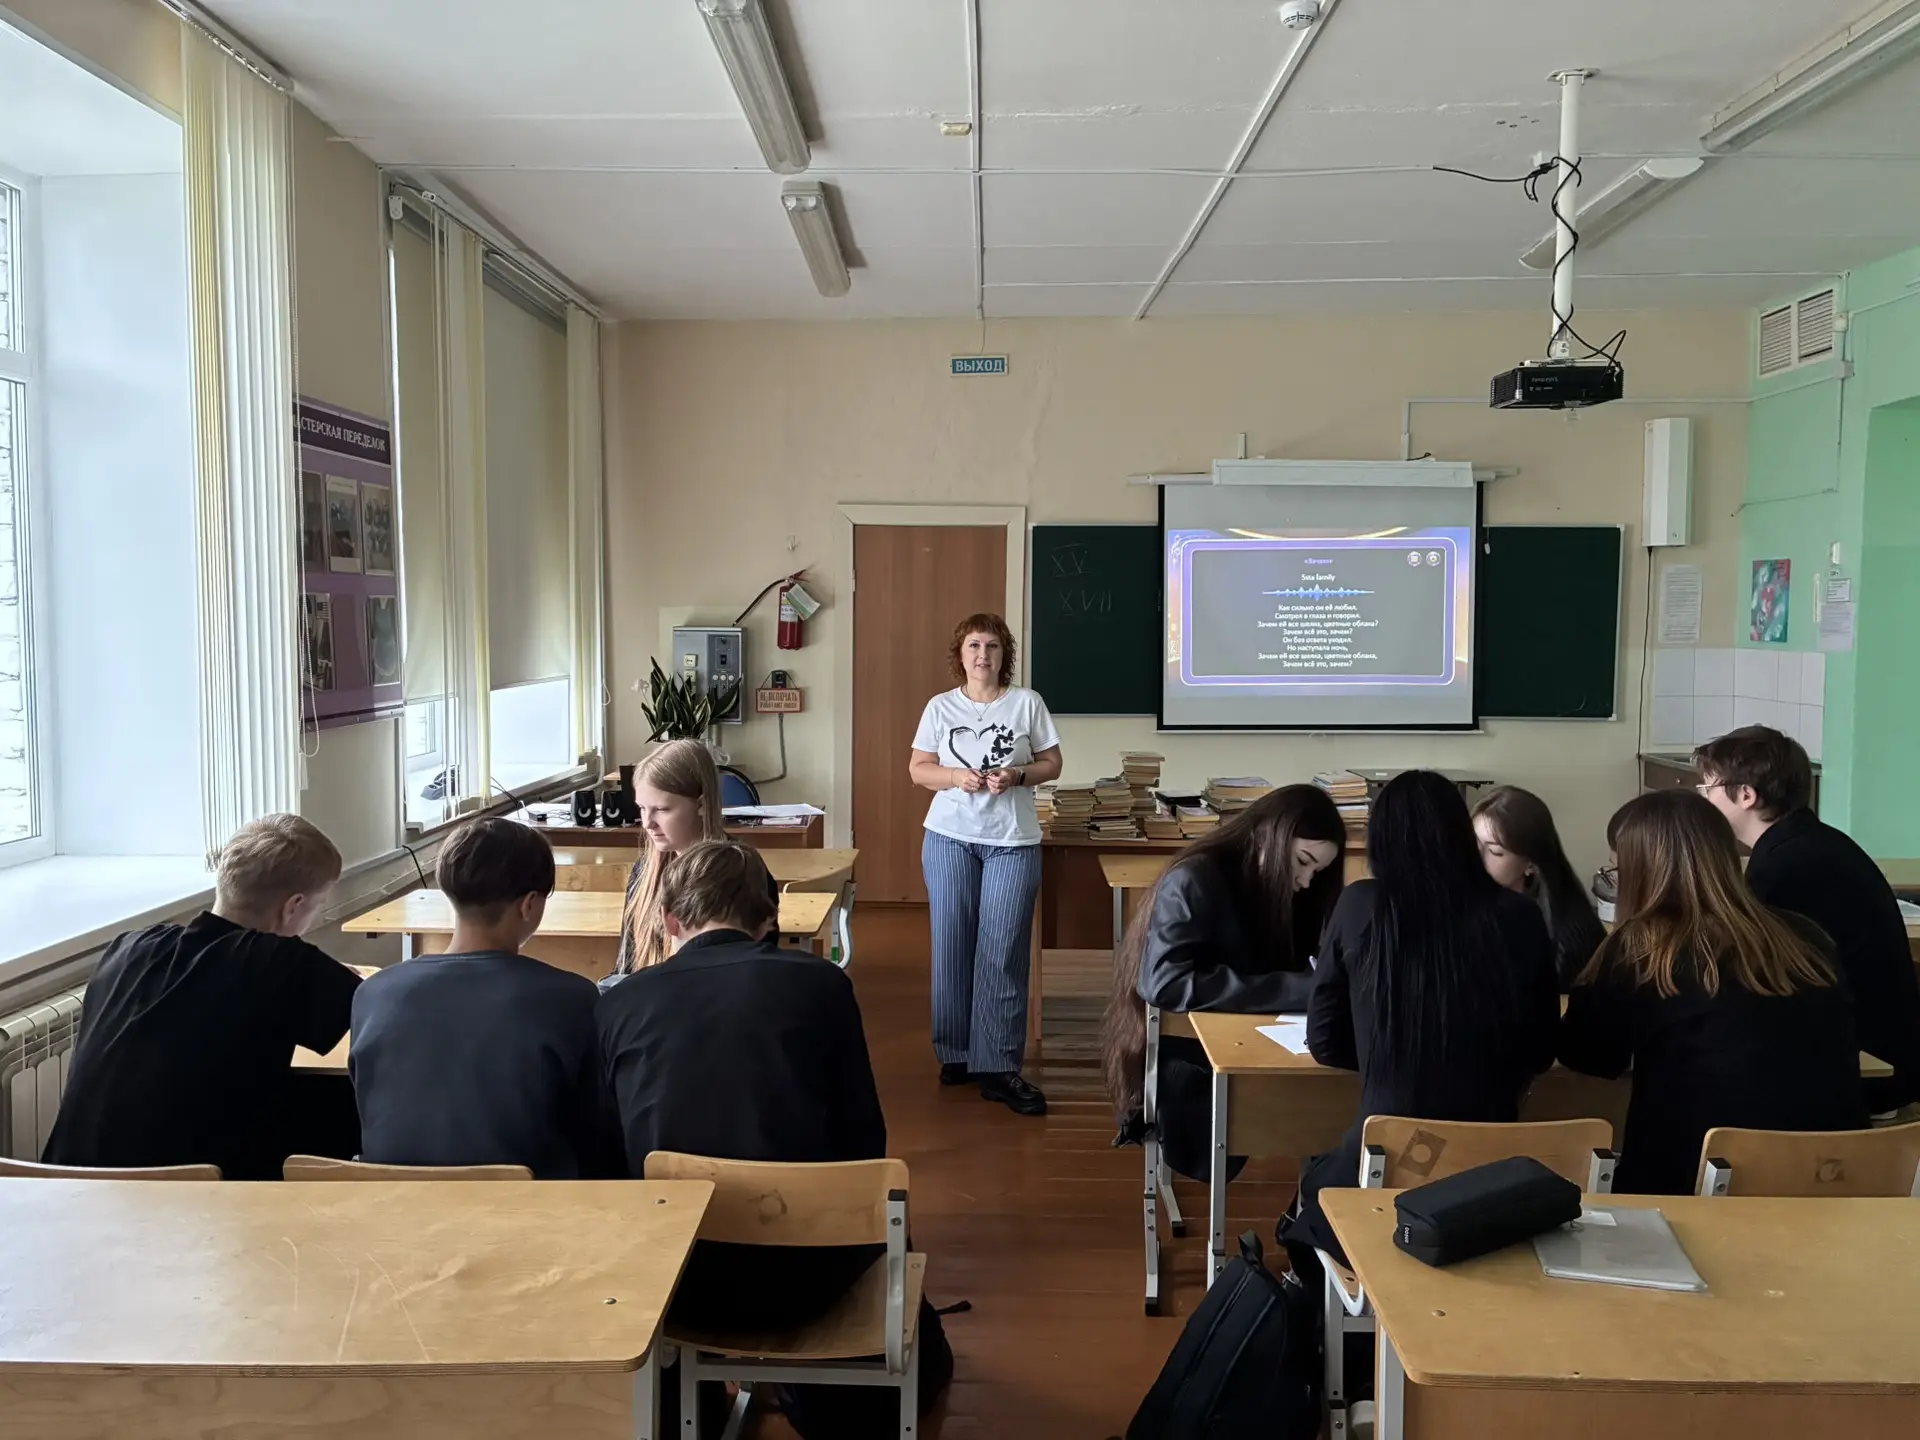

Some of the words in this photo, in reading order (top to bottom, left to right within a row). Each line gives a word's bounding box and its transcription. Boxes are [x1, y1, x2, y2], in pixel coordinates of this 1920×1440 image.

[955, 359, 1003, 373] ВЫХОД
[343, 429, 386, 451] ПЕРЕДЕЛОК
[1316, 573, 1336, 582] family
[1058, 589, 1112, 614] XVII
